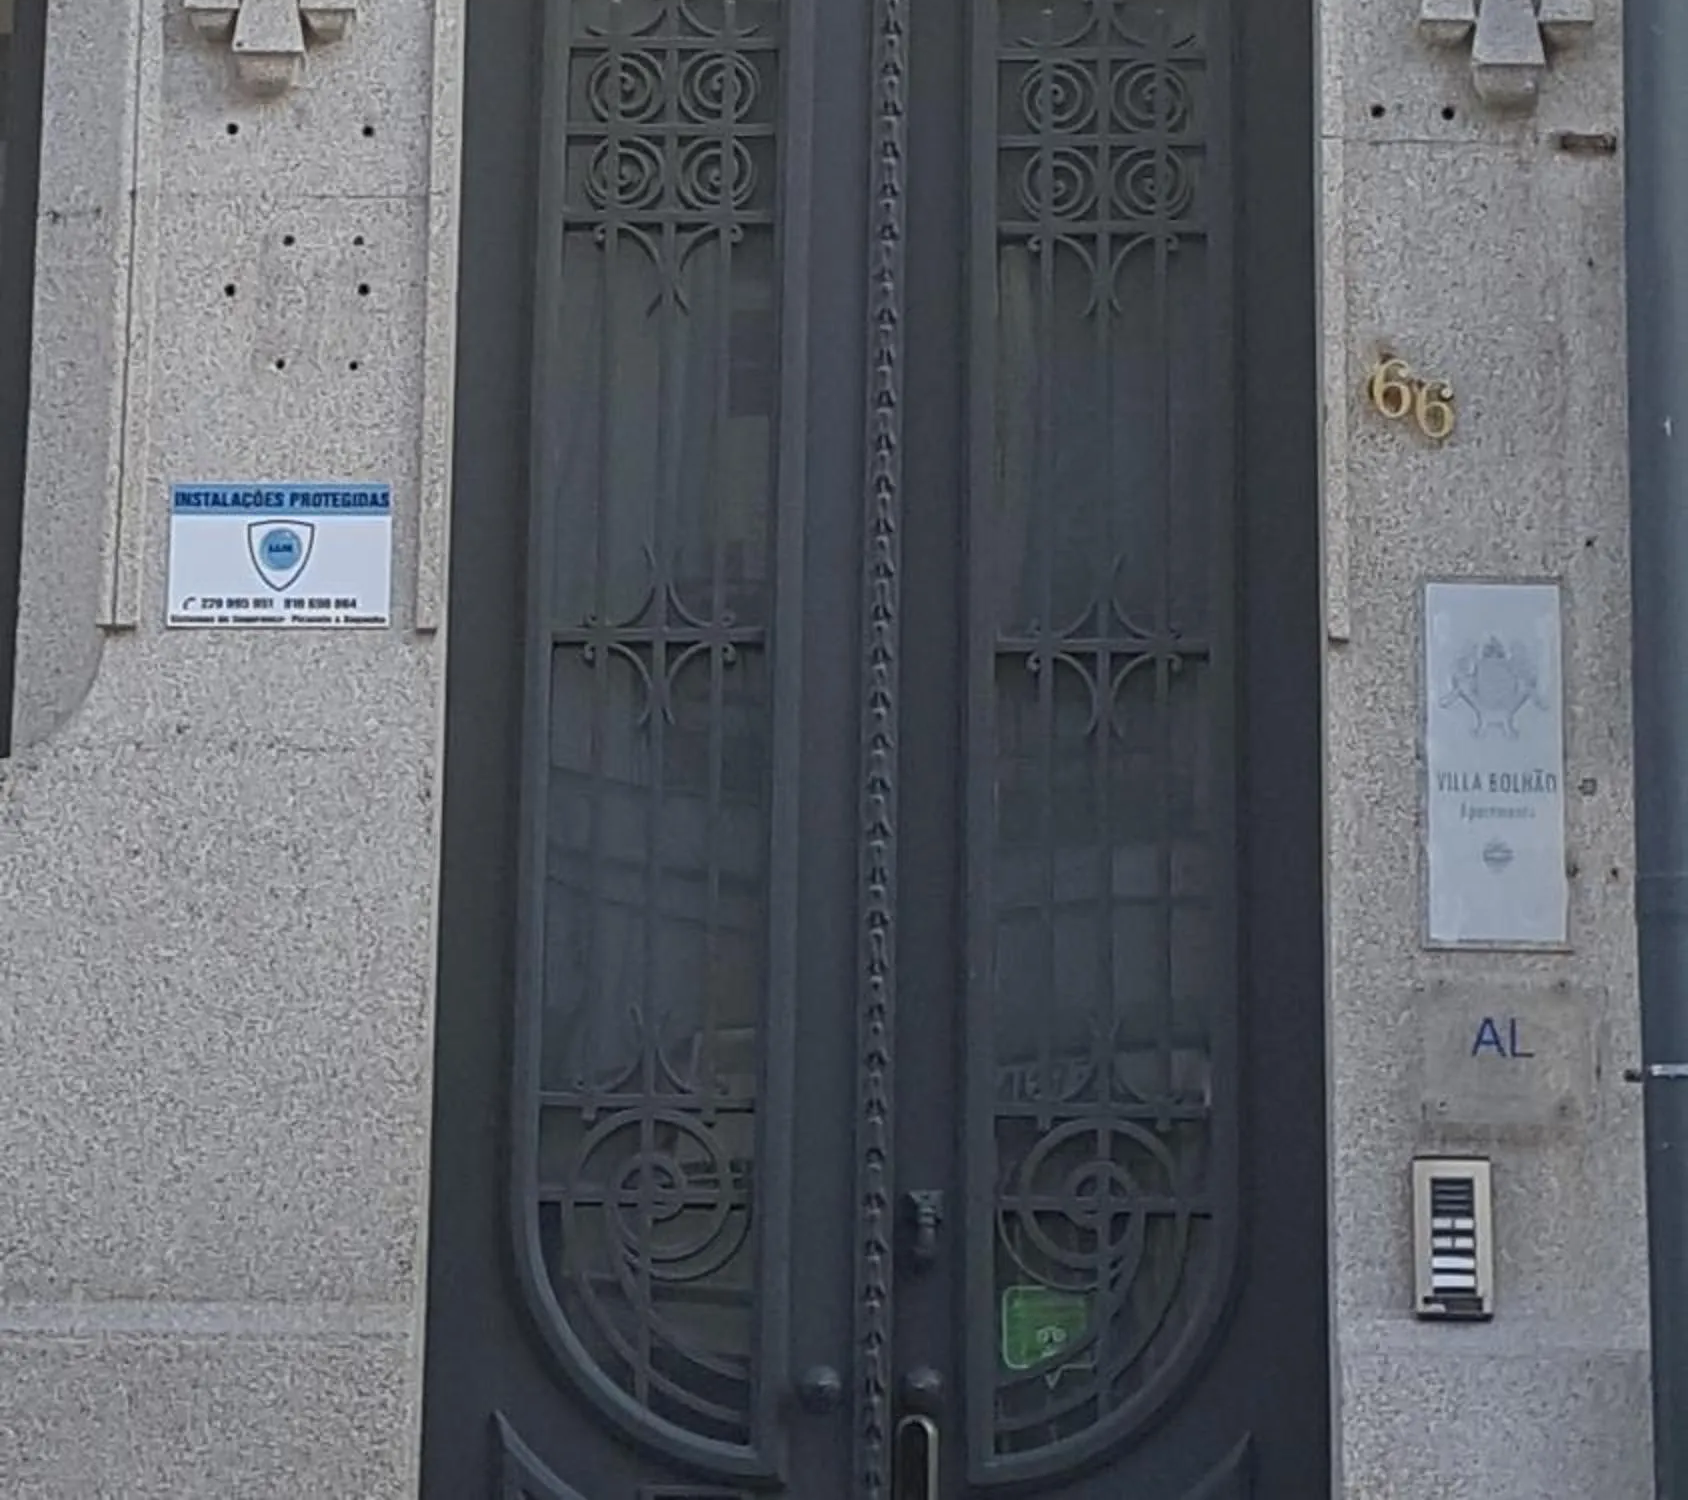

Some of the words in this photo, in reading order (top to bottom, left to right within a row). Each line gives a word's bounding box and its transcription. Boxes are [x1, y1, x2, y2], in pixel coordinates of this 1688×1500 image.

[1373, 358, 1454, 438] 66
[174, 489, 285, 508] INSTALAÇÕES
[289, 491, 390, 508] PROTEGIDAS
[1437, 771, 1482, 792] VILLA
[1488, 768, 1557, 794] BOLHÃO
[1472, 1017, 1536, 1058] AL
